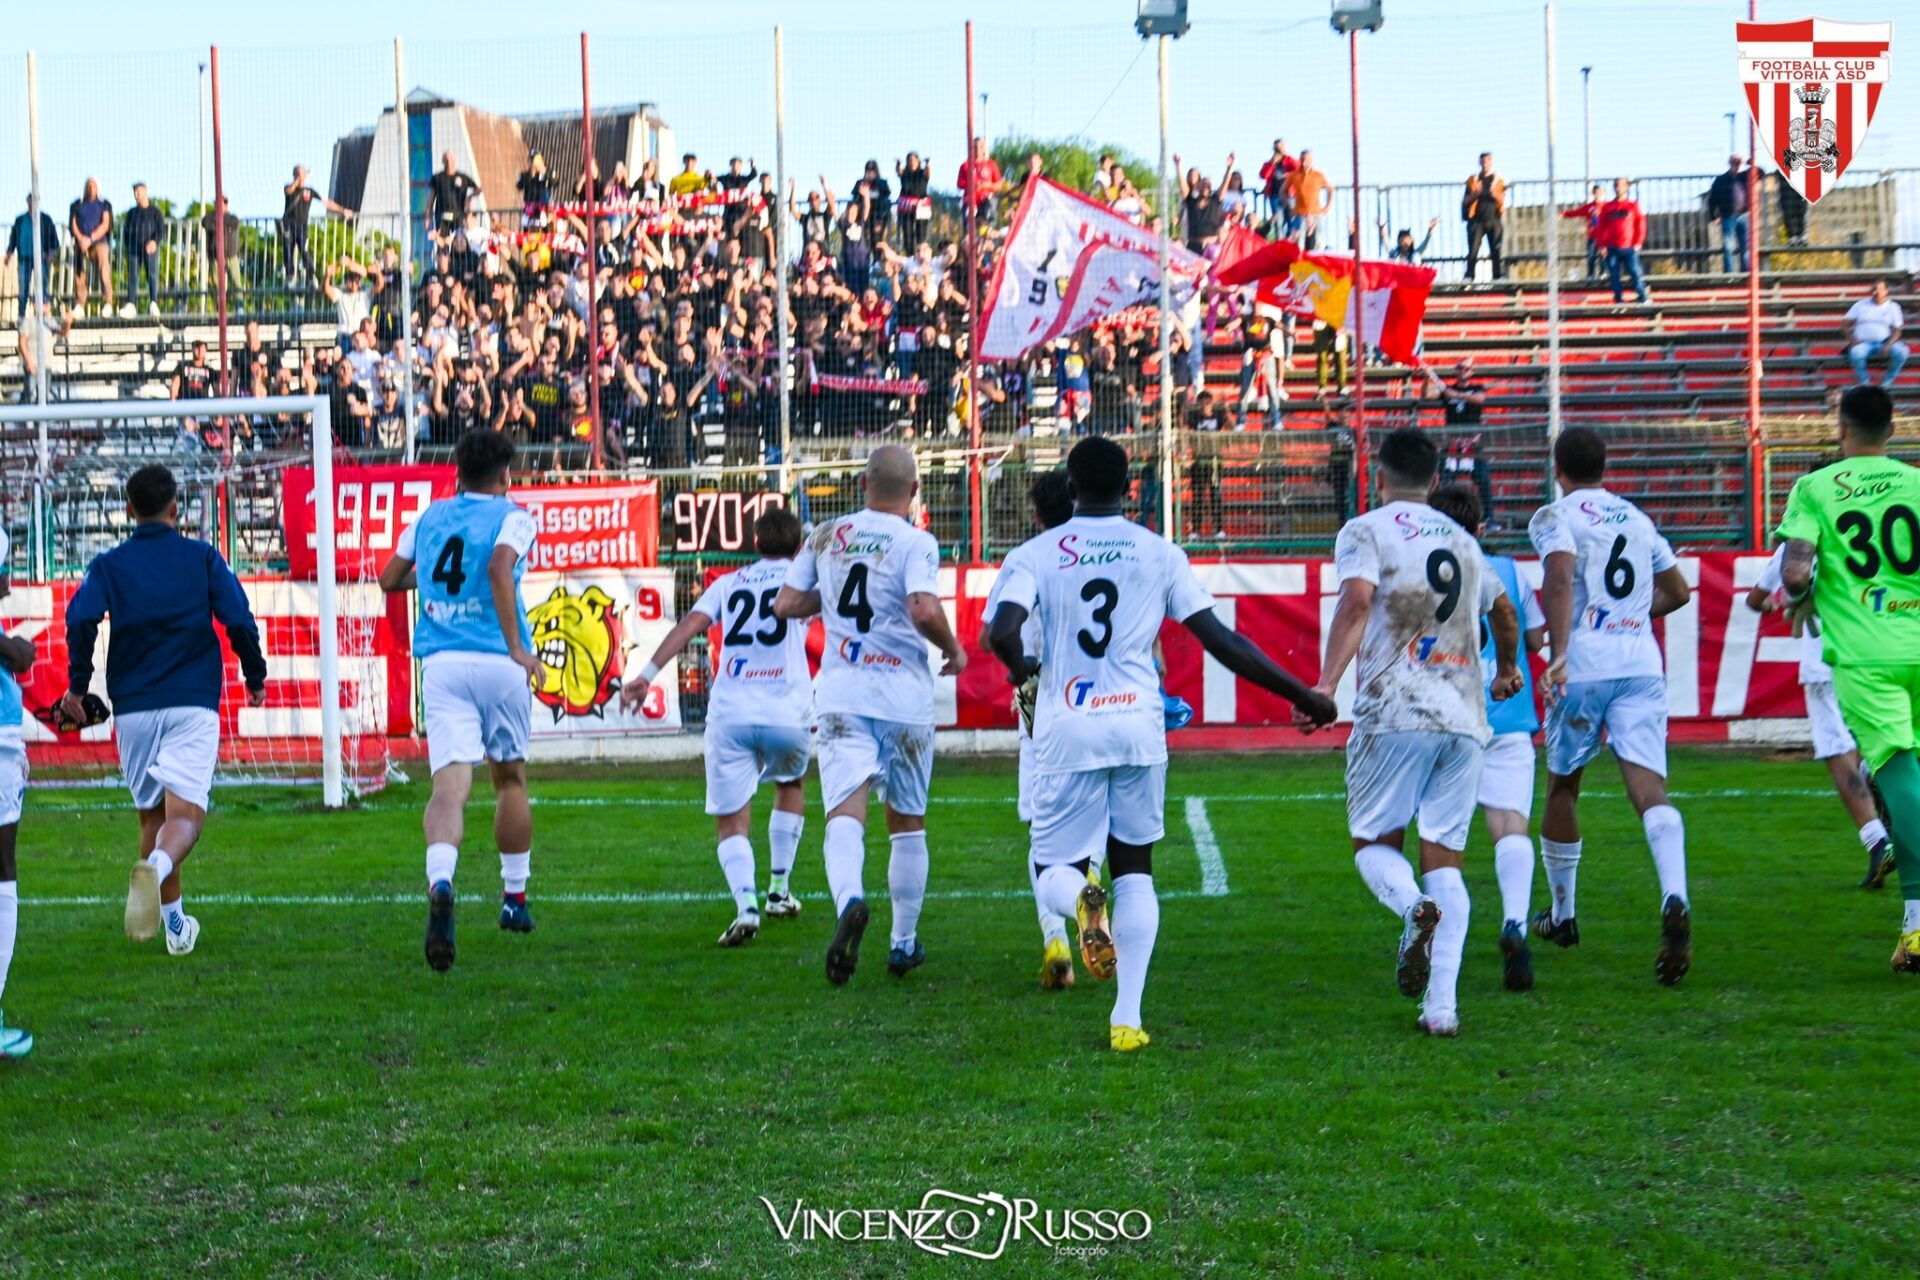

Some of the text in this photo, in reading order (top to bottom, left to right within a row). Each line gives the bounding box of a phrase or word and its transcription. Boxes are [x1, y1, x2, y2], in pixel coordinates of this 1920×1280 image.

[432, 535, 466, 596] 4
[1058, 534, 1122, 570] Sara
[1604, 533, 1635, 600] 6
[1835, 503, 1920, 580] 30
[638, 587, 662, 621] 9
[836, 562, 874, 634] 4
[1426, 548, 1462, 623] 9
[724, 587, 788, 648] 25
[1077, 577, 1119, 659] 3
[642, 684, 667, 721] 3
[1091, 693, 1137, 709] group
